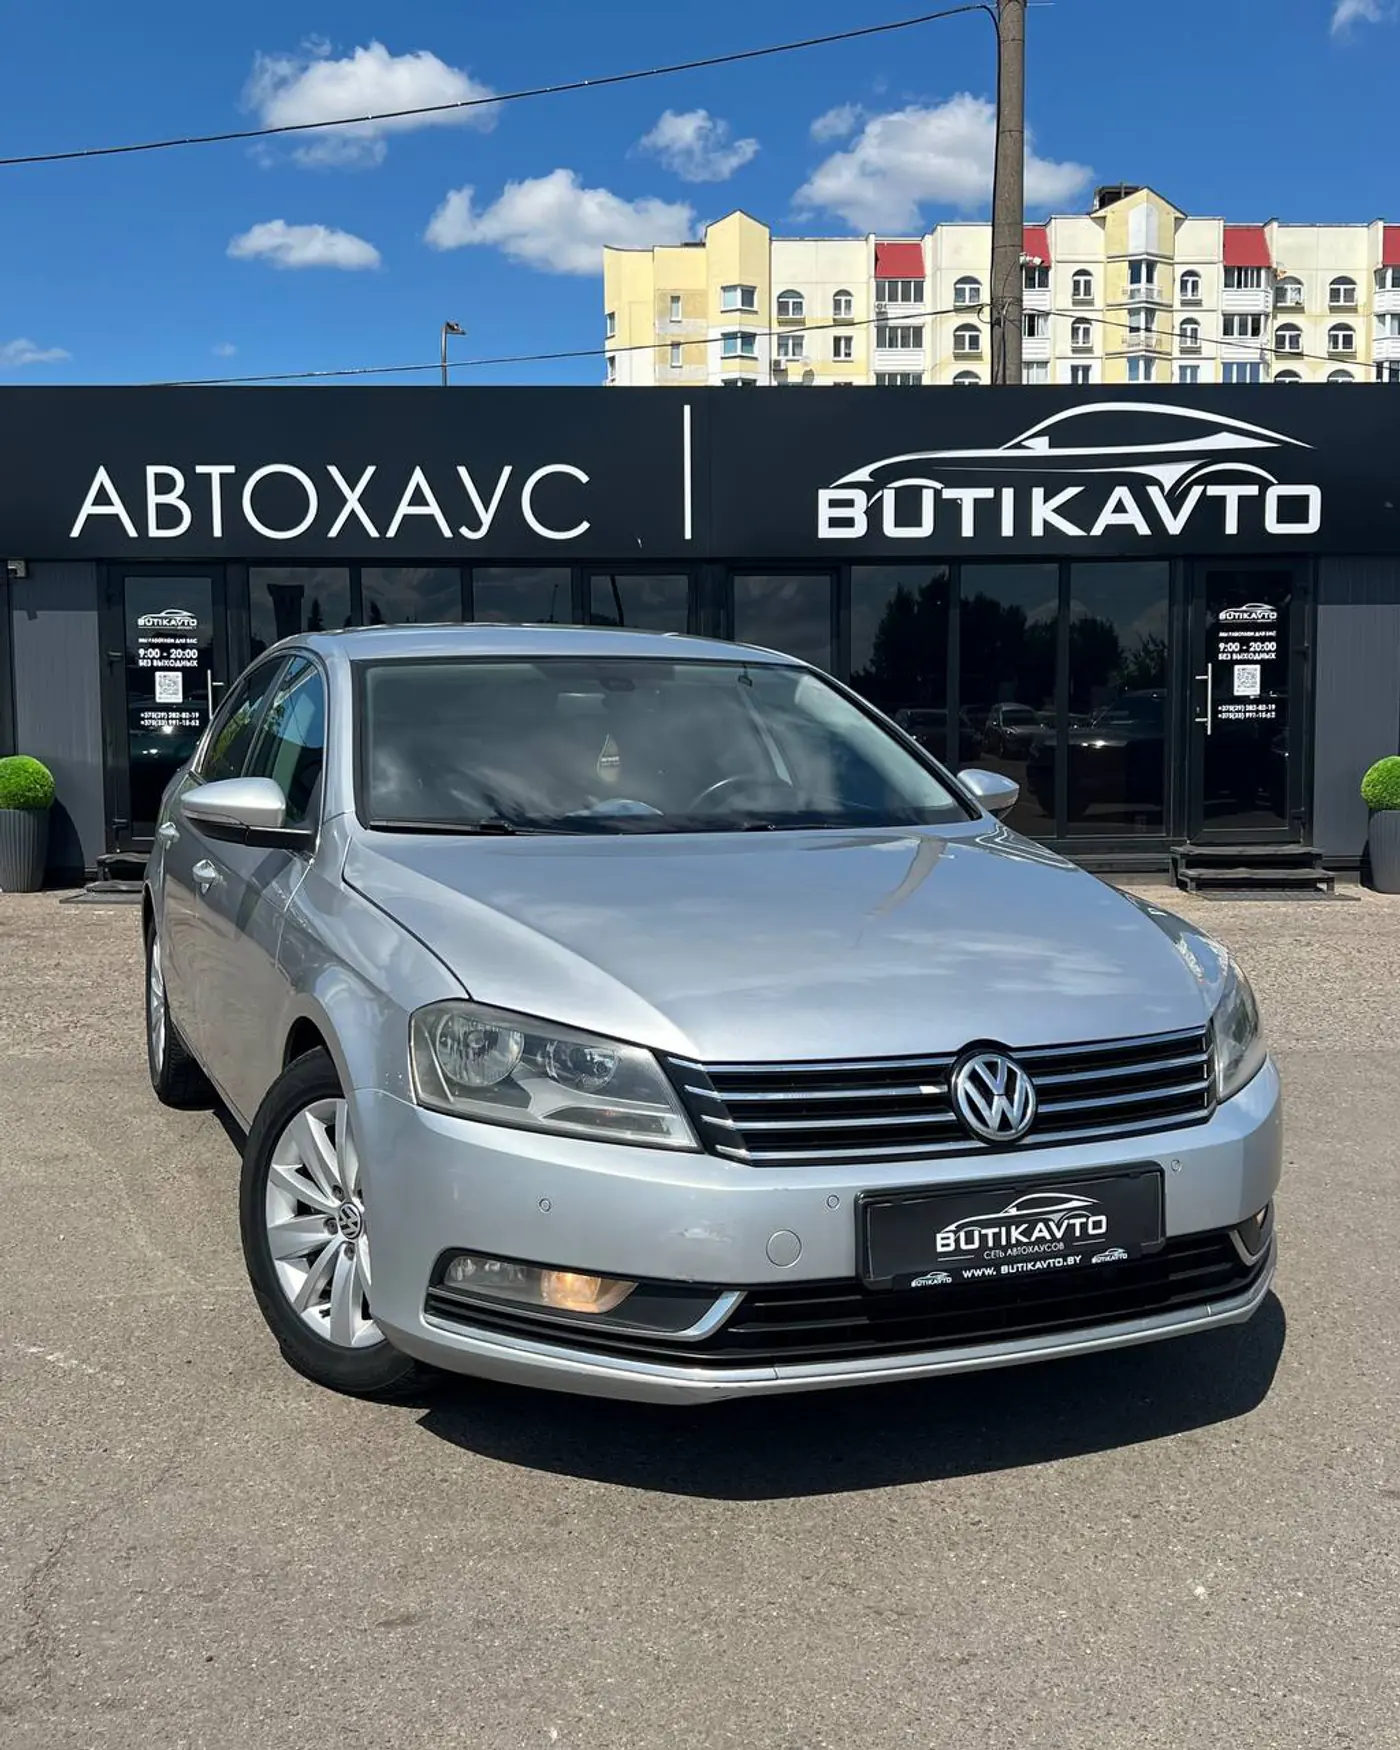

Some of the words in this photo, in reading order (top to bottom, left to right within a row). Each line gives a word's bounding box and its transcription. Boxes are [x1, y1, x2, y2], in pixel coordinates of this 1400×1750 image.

[69, 463, 591, 539] АВТОХАУС
[817, 483, 1322, 539] BUTIKAVTO
[137, 617, 198, 626] BUTIKAVTO
[1218, 611, 1278, 620] BUTIKAVTO
[138, 648, 160, 658] 9:00
[169, 648, 198, 658] 20:00
[1218, 642, 1240, 652] 9:00
[1249, 641, 1277, 652] 20:00
[138, 659, 151, 667] БЕЗ
[153, 659, 198, 667] ВЫХОДНЫХ
[1218, 652, 1231, 660] БЕЗ
[1232, 652, 1277, 660] ВЫХОДНЫХ
[959, 1056, 1032, 1137] VW
[936, 1214, 1108, 1253] BUTIKAVTO
[983, 1248, 1004, 1260] СЕТЬ
[1006, 1241, 1065, 1257] АВТОХАУСОВ
[962, 1266, 997, 1279] WWW.
[1001, 1255, 1083, 1275] BUTIKAVTO.BY
